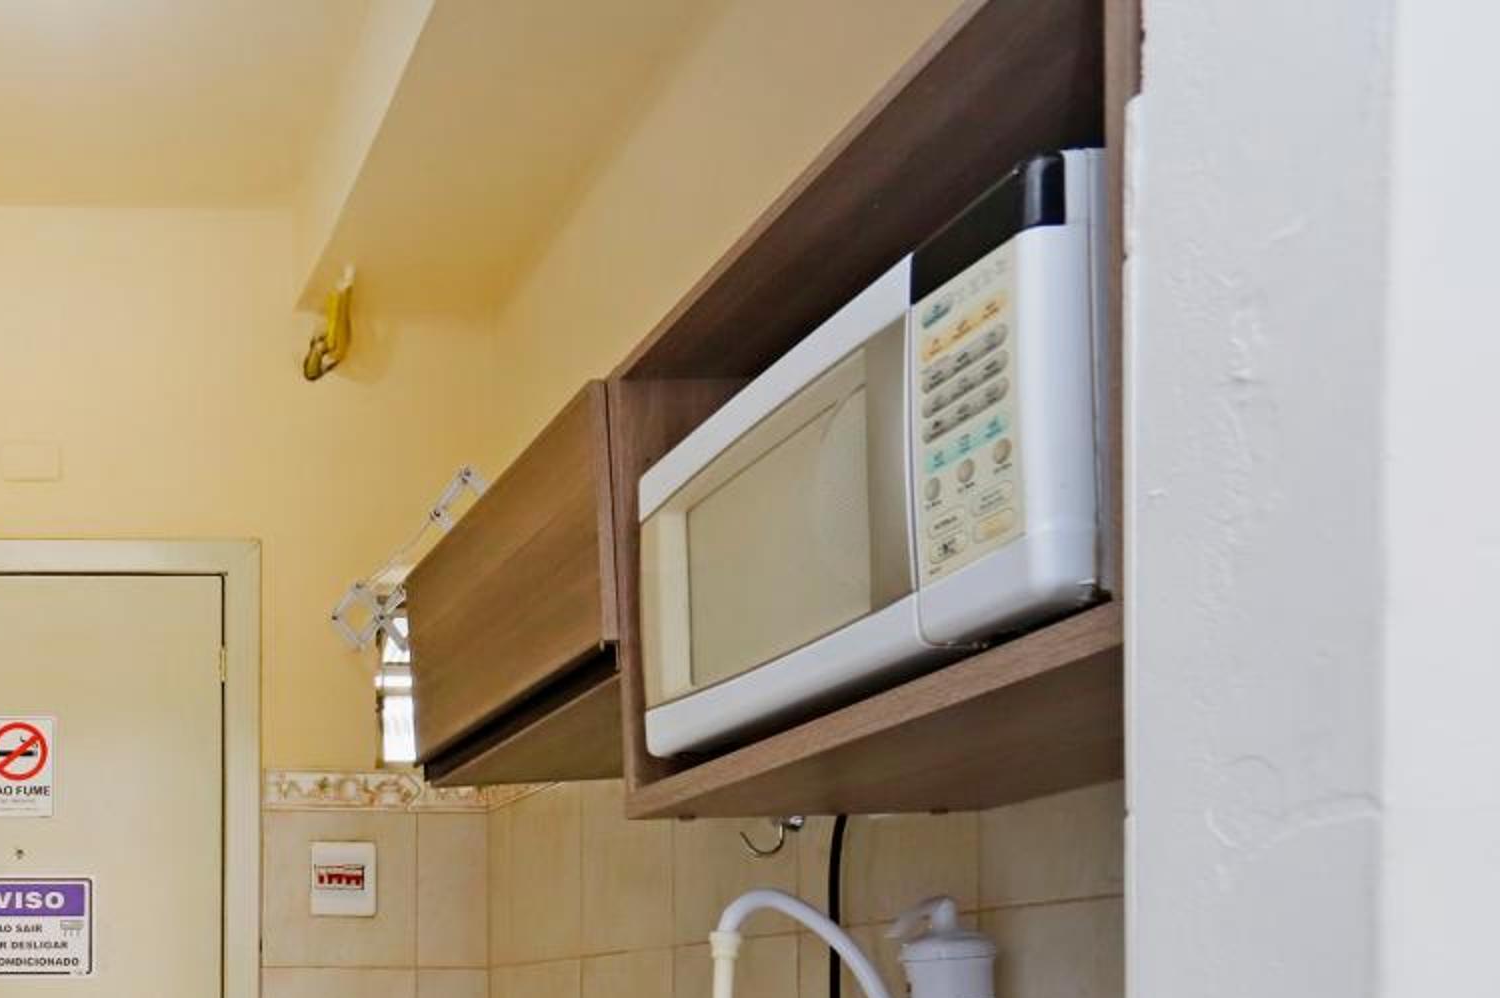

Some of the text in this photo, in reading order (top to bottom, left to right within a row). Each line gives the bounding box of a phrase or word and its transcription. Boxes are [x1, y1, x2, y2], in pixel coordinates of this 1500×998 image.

[15, 785, 51, 796] FUME
[15, 924, 43, 934] SAIR
[11, 941, 69, 950] DESLIGAR
